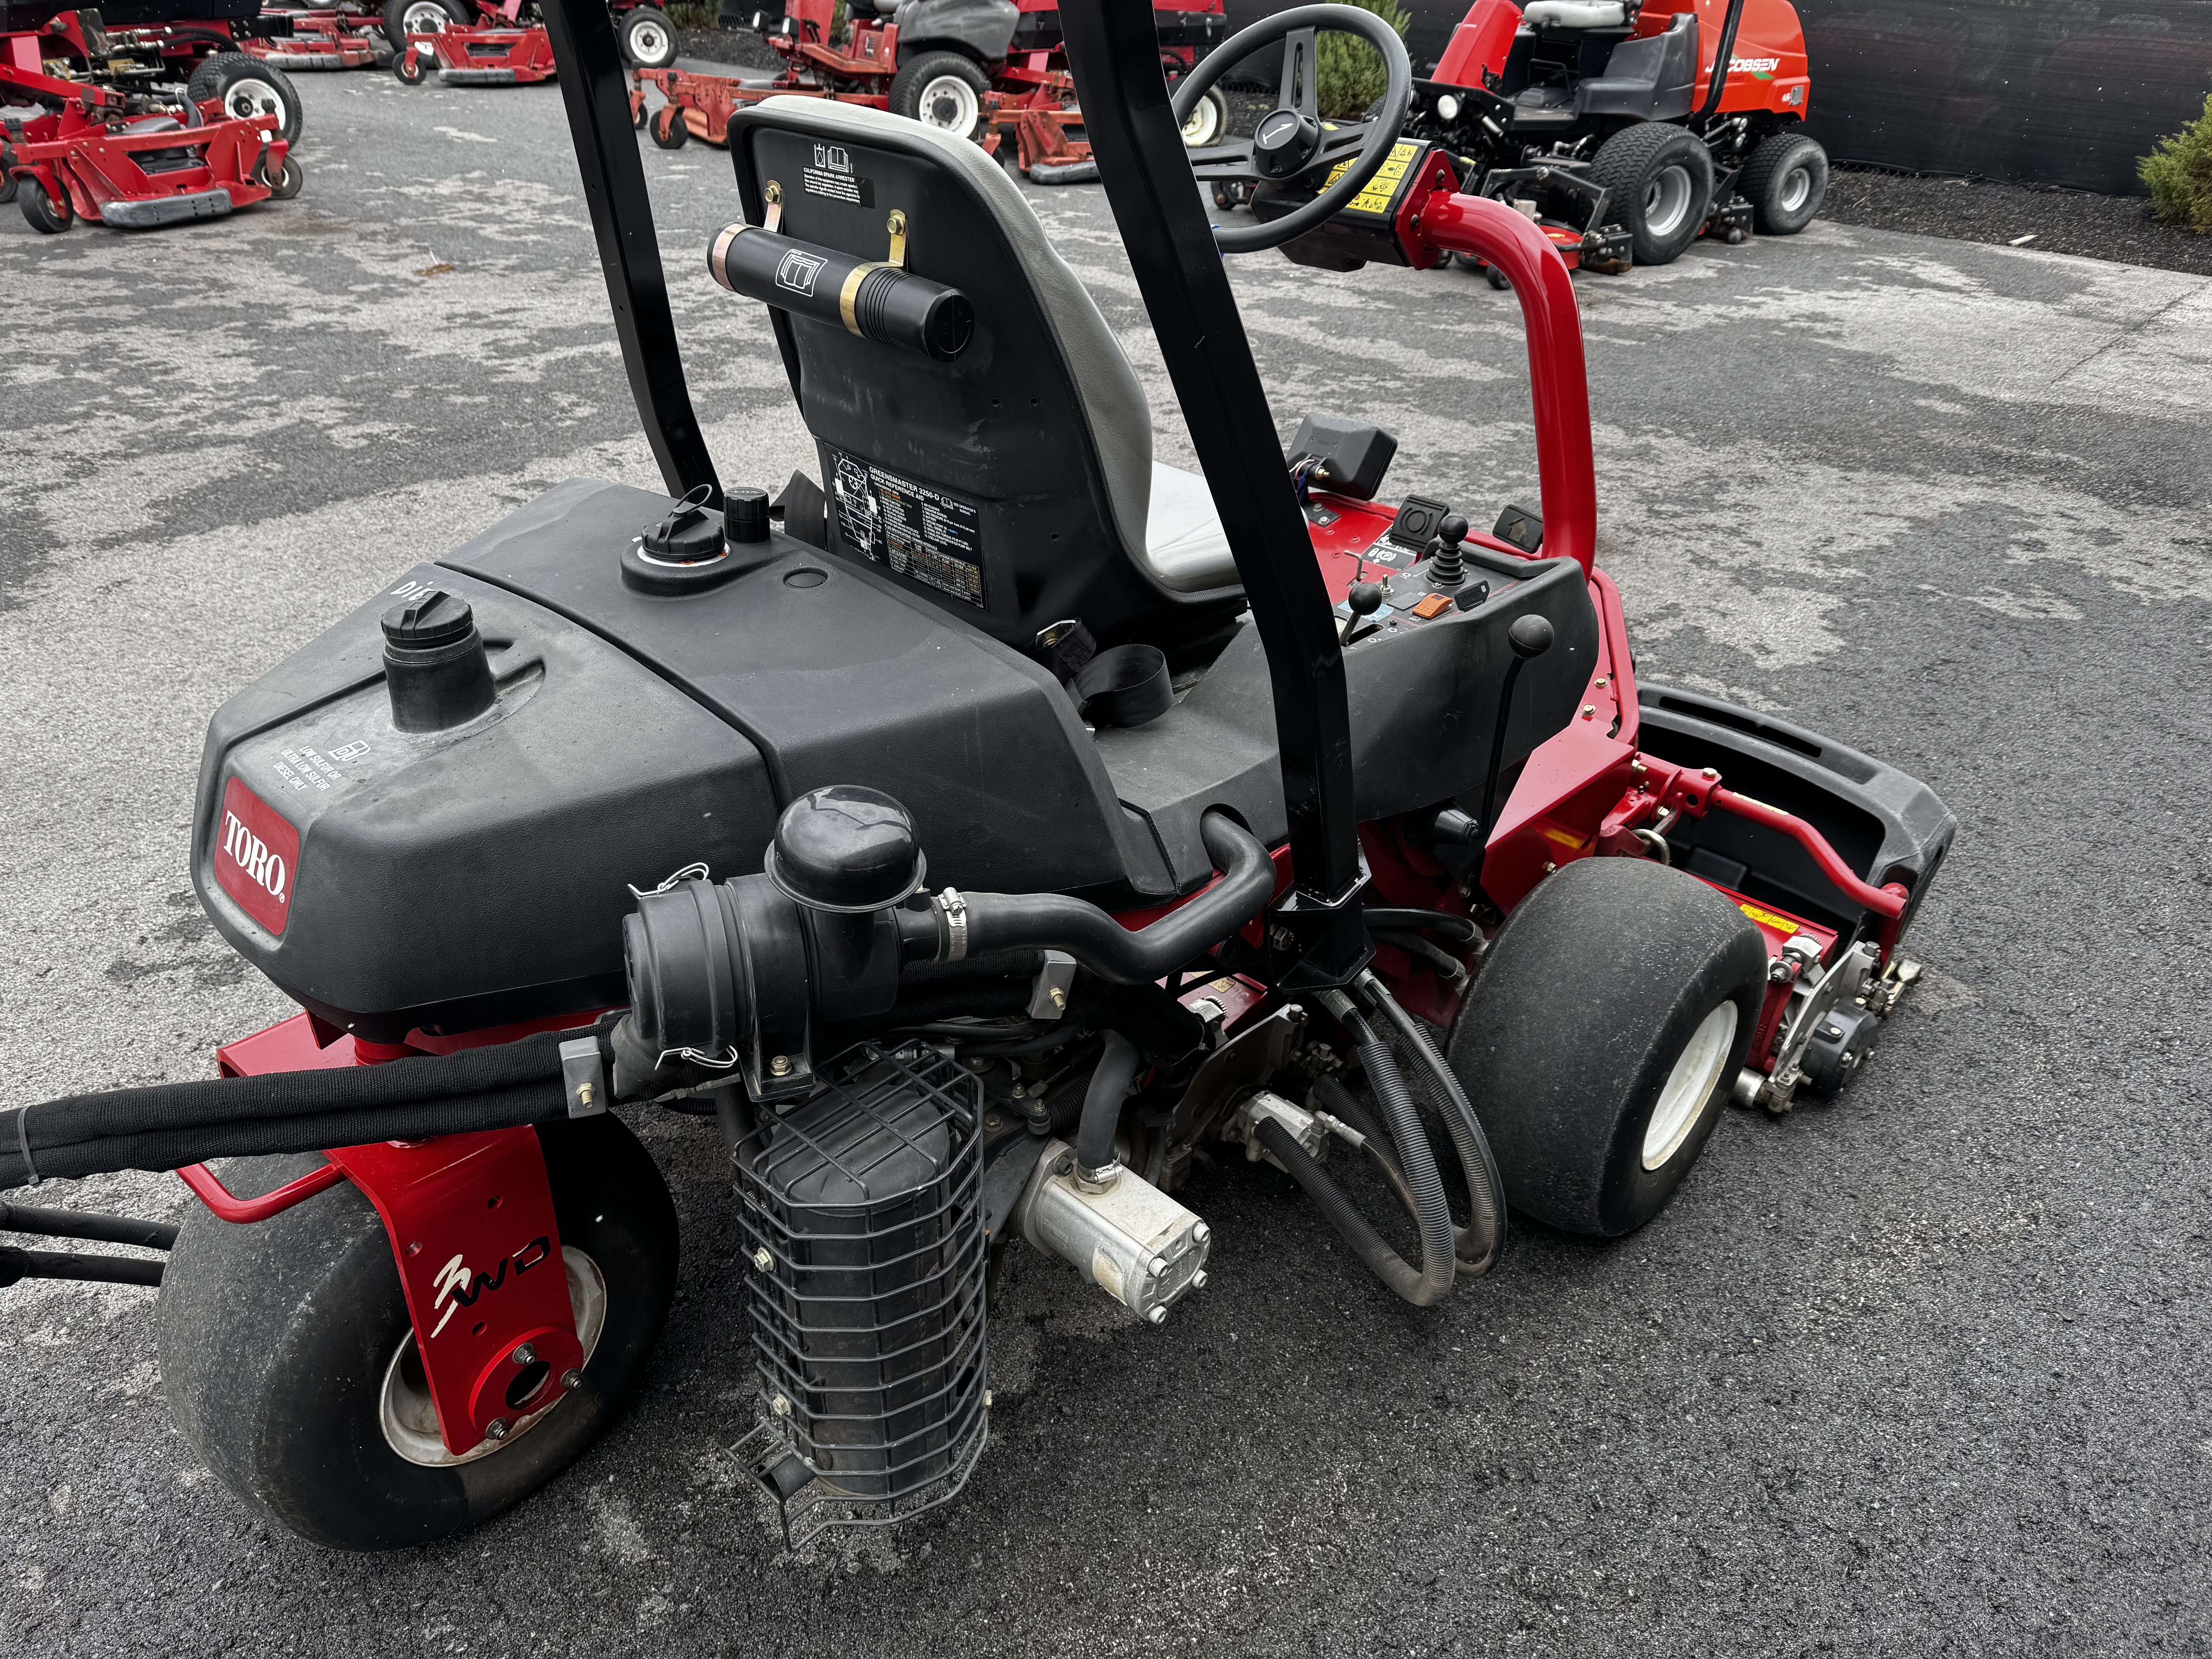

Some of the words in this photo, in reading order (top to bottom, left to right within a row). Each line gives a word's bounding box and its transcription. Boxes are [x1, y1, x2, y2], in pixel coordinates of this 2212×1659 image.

[1705, 58, 1780, 73] JCOBSEN
[804, 167, 823, 176] CALIFORNIA
[869, 466, 917, 492] GREENSMASTER
[919, 488, 939, 500] 3250-D
[871, 474, 885, 484] QUICK
[886, 481, 915, 497] REFERENCE
[1460, 591, 1482, 604] TORO
[272, 761, 295, 780] DIESEL
[289, 776, 309, 791] ONLY
[281, 748, 302, 765] ULTRA
[295, 761, 313, 774] LOW
[305, 771, 331, 792] SULFUR
[299, 745, 318, 757] LOW
[309, 755, 335, 774] SULFUR
[327, 771, 342, 780] OR
[431, 1235, 550, 1338] 3WD
